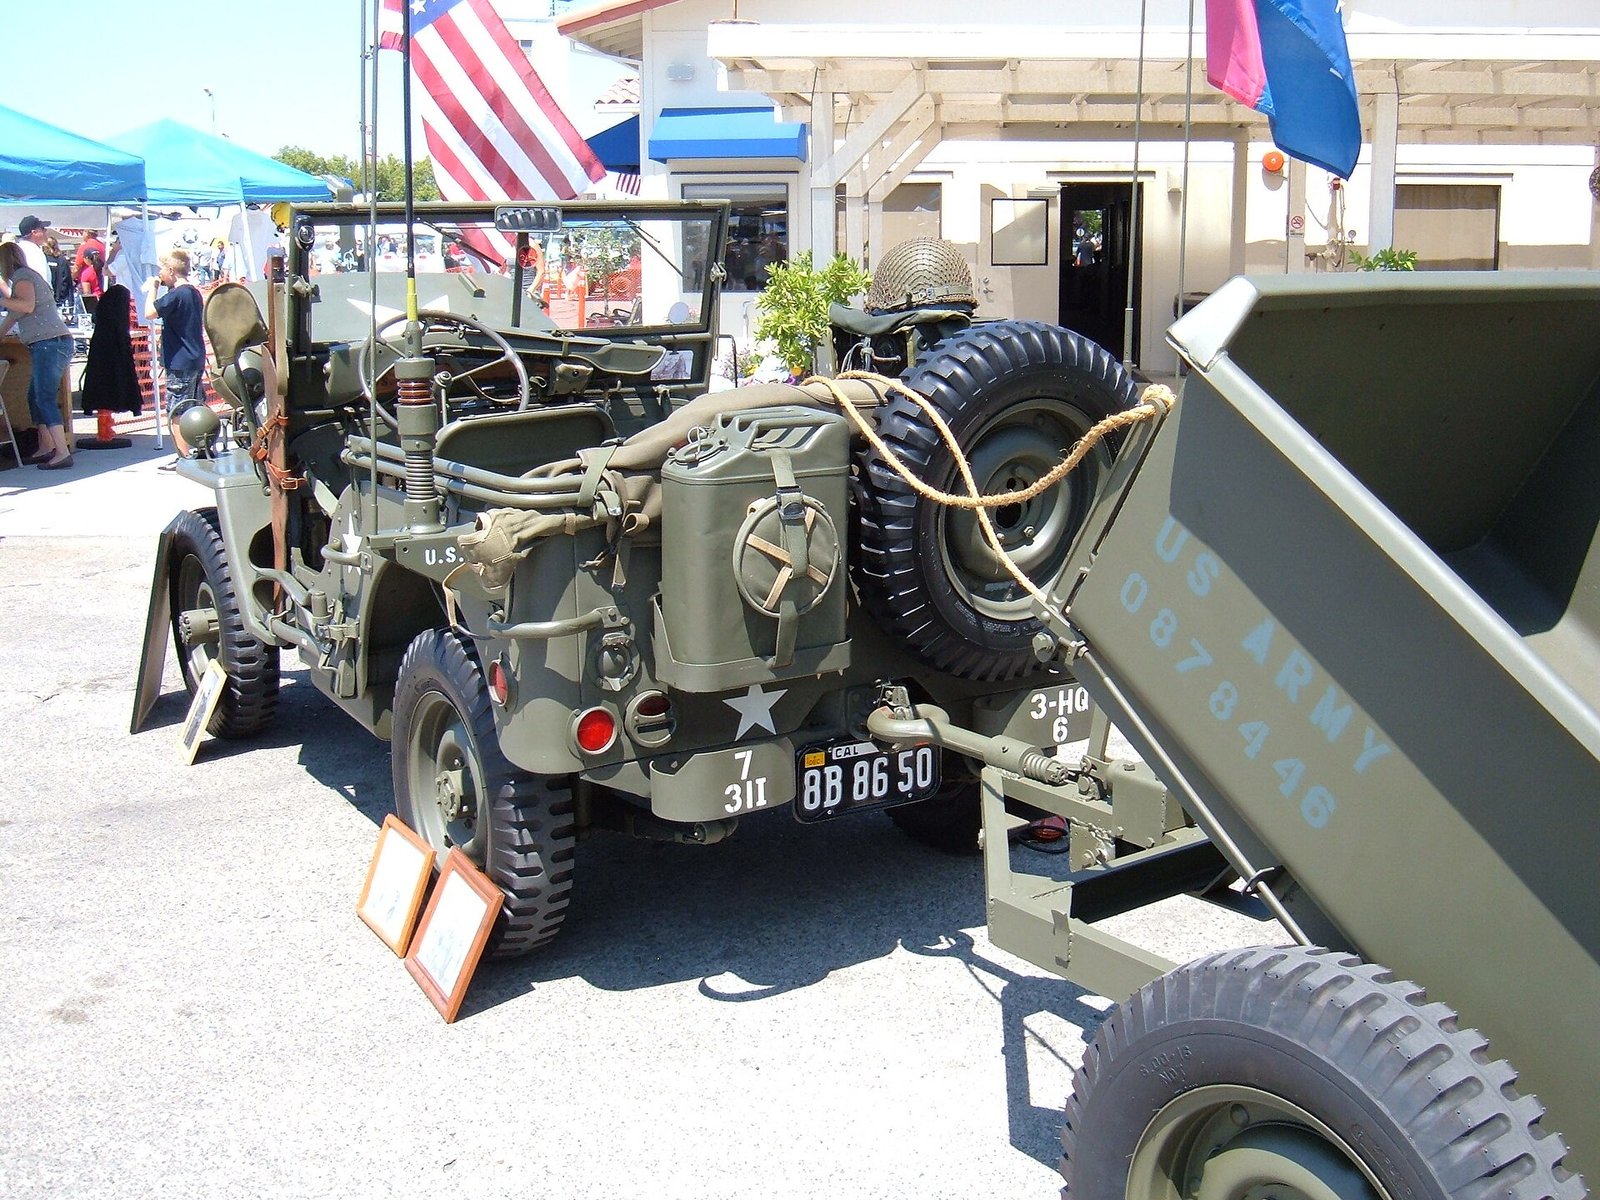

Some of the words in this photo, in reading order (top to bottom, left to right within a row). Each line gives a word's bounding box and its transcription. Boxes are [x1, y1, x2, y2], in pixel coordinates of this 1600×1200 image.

[425, 546, 464, 565] U.S.
[1155, 515, 1221, 597] US
[1241, 617, 1393, 775] ARMY
[1030, 686, 1089, 720] 3-HQ
[1119, 571, 1336, 829] 0878446
[1052, 716, 1069, 743] 6
[734, 749, 753, 781] 7
[835, 747, 859, 758] CAL
[803, 764, 842, 810] 8B
[852, 757, 888, 801] 86
[897, 747, 932, 793] 50
